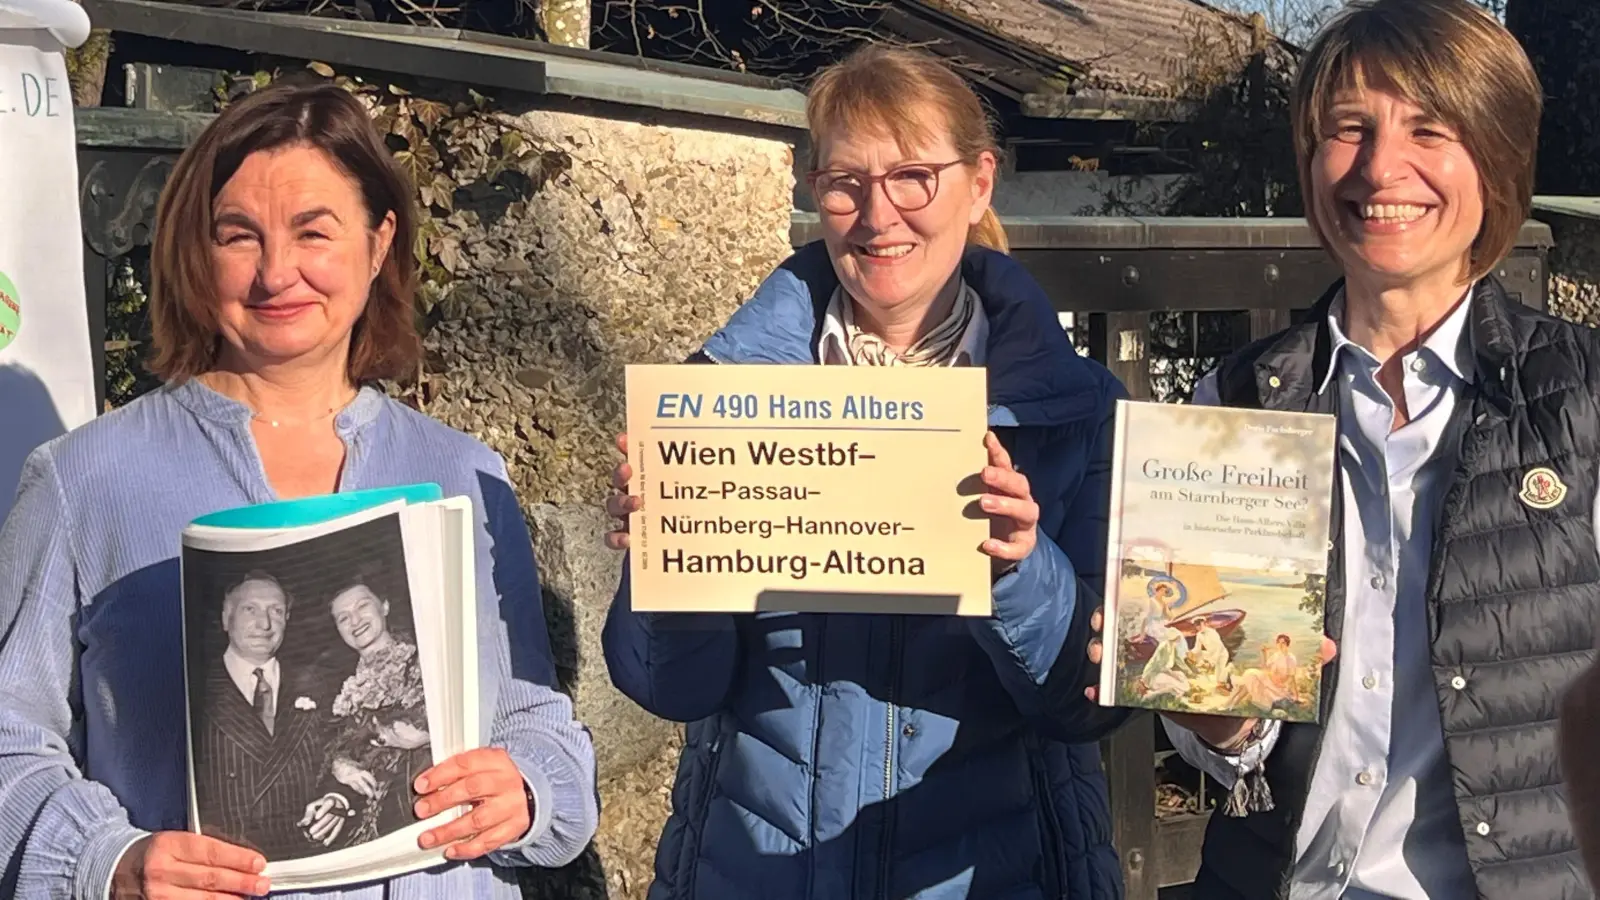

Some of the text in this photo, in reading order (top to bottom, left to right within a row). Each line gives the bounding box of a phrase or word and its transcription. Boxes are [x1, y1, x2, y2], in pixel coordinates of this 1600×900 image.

[656, 393, 924, 420] EN 490 Hans Albers
[658, 441, 735, 465] Wien
[1142, 458, 1308, 490] Große Freiheit
[1150, 488, 1308, 511] am Starnberger See?
[662, 548, 925, 579] Hamburg-Altona
